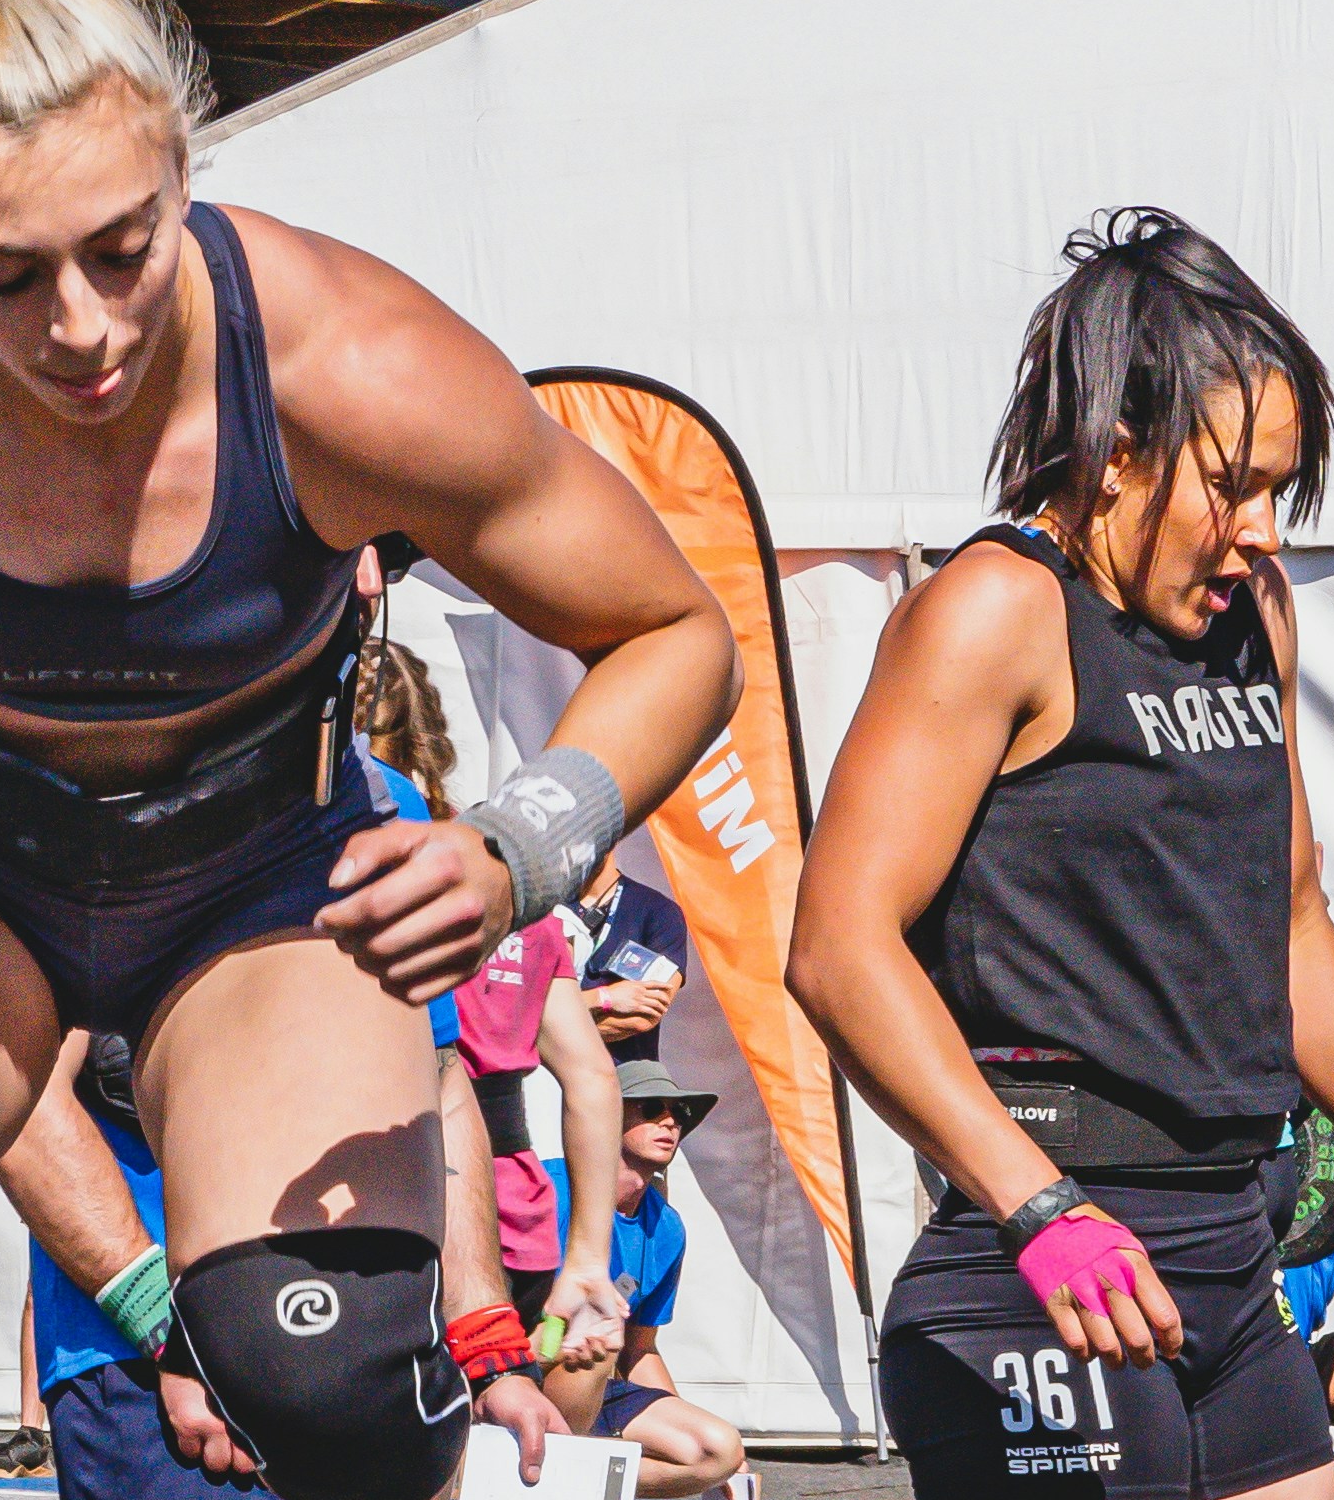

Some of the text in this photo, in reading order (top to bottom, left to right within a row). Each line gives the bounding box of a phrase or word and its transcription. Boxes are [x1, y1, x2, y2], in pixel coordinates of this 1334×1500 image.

[1004, 1105, 1058, 1122] SLOVE
[992, 1348, 1114, 1433] 361
[1005, 1442, 1120, 1457] NORTHERN
[1008, 1454, 1122, 1475] SPIRIT
